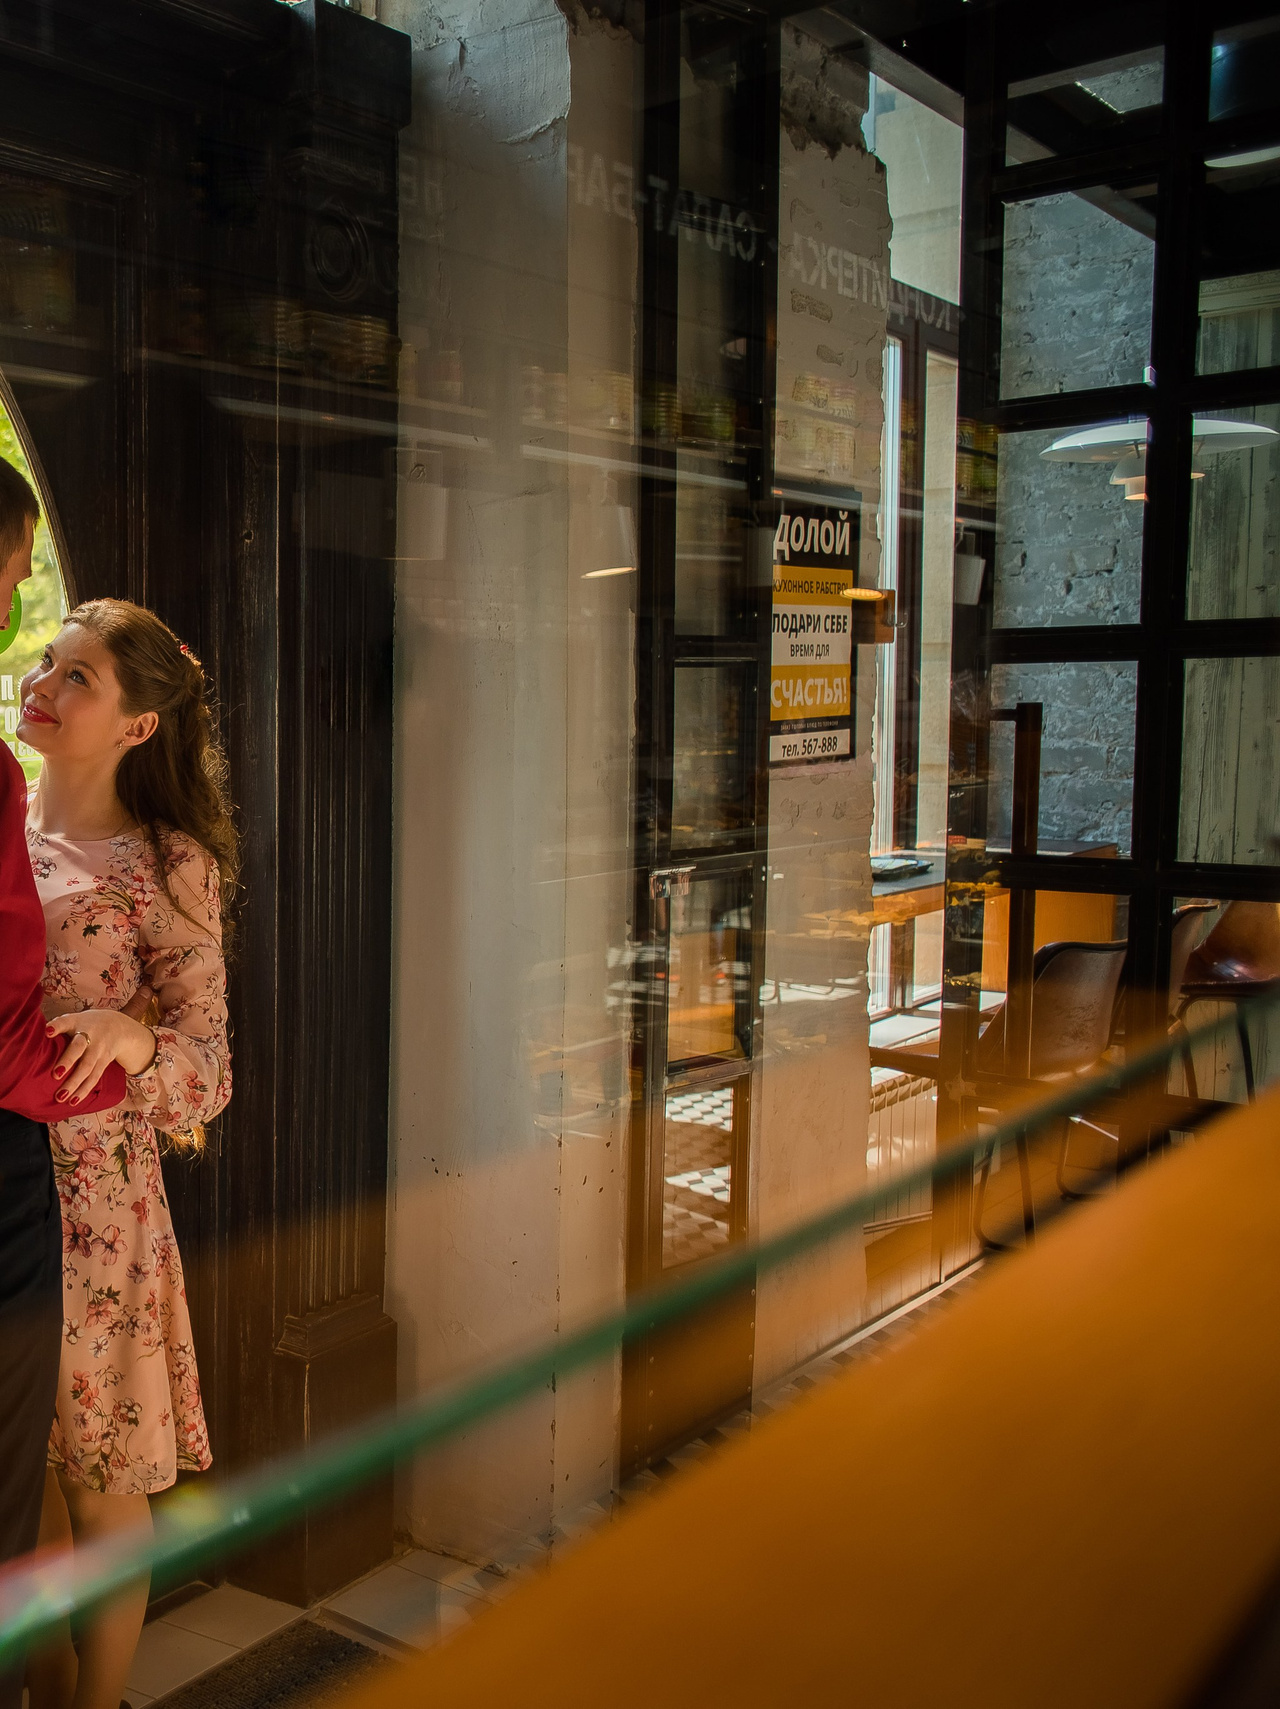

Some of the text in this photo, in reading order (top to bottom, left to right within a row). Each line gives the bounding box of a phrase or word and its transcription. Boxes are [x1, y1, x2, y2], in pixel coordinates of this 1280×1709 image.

[773, 510, 850, 561] ДОЛОЙ
[772, 579, 814, 594] КУХОННОЕ
[772, 613, 847, 639] ПОДАРИ СЕБЕ
[790, 643, 830, 659] ВРЕМЯ ДЛЯ
[770, 675, 847, 708] СЧАСТЬЯ!
[781, 736, 838, 758] тел. 567-888
